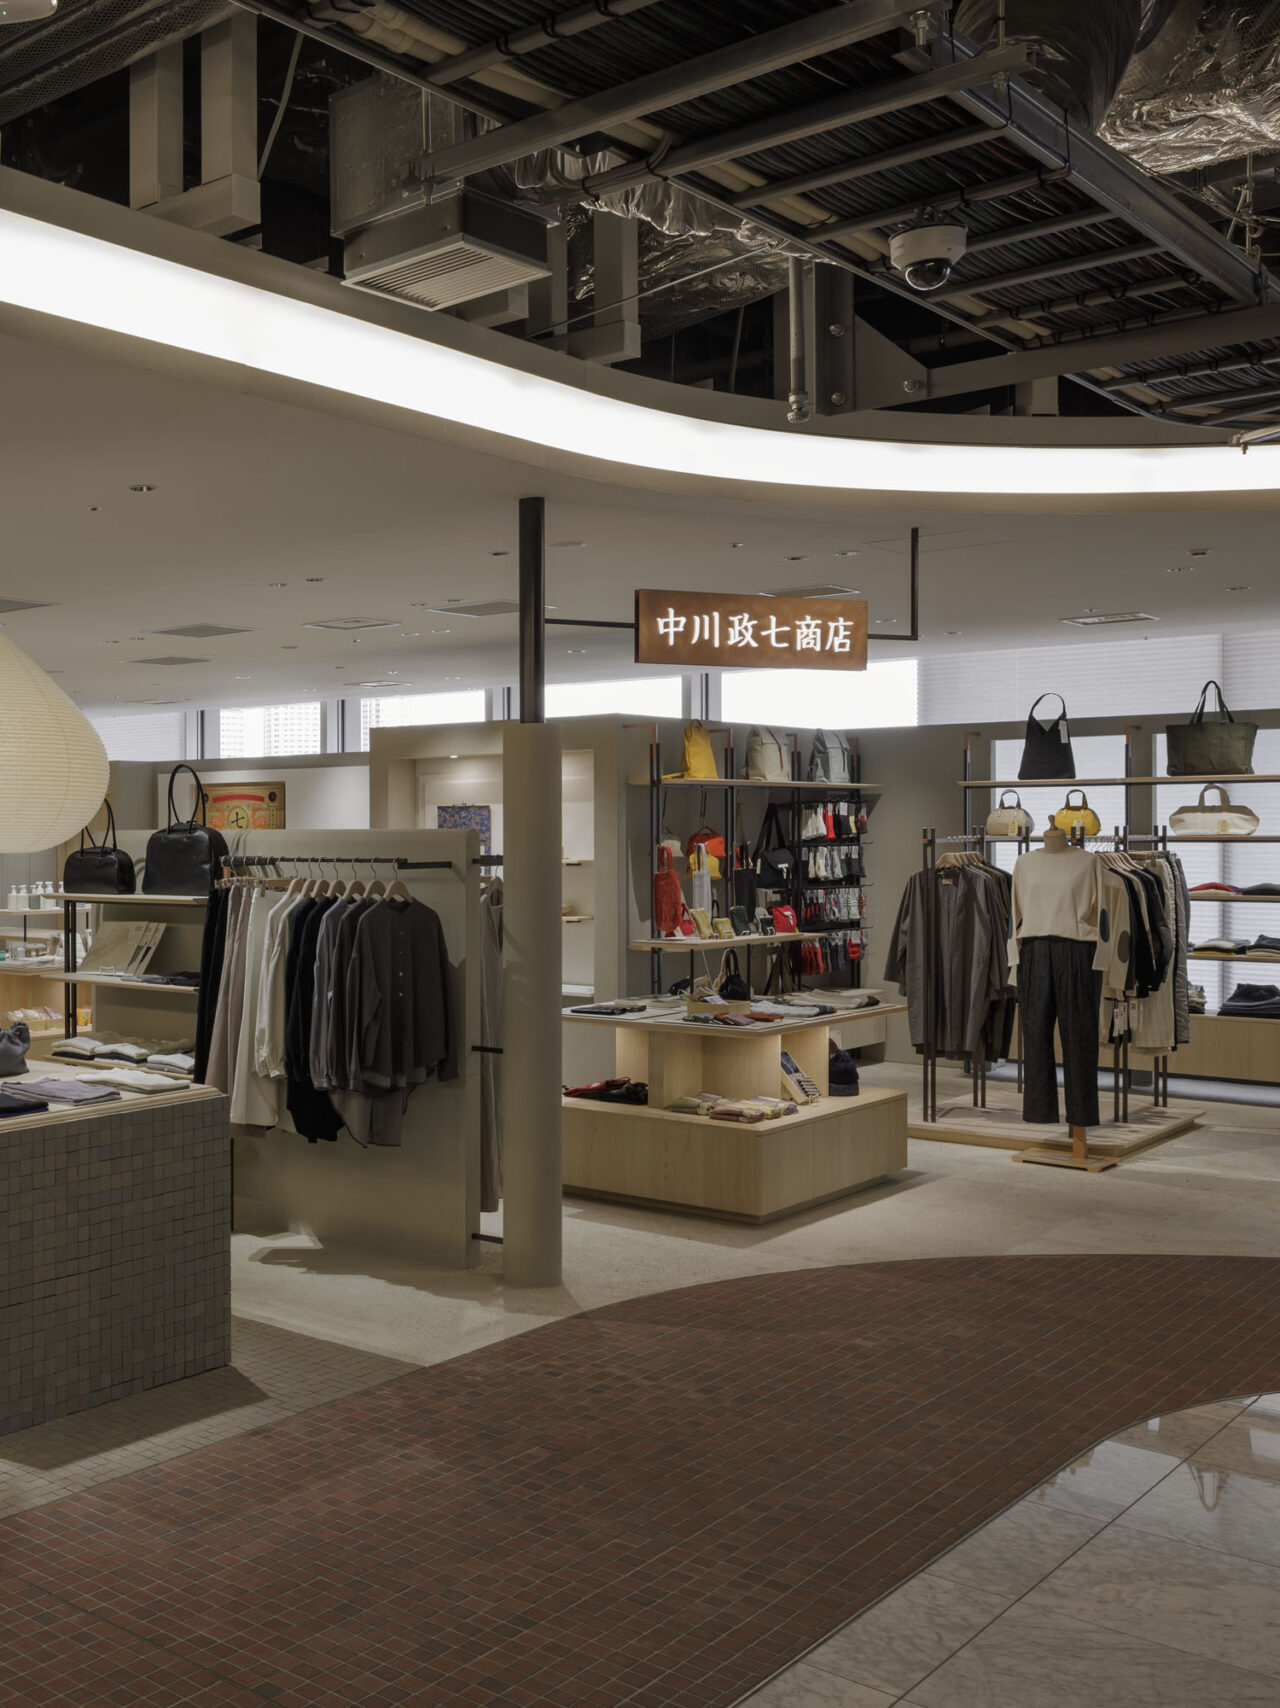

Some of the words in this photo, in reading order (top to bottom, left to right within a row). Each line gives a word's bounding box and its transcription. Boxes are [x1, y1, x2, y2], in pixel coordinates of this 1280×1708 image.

[656, 607, 854, 652] 中川政七商店
